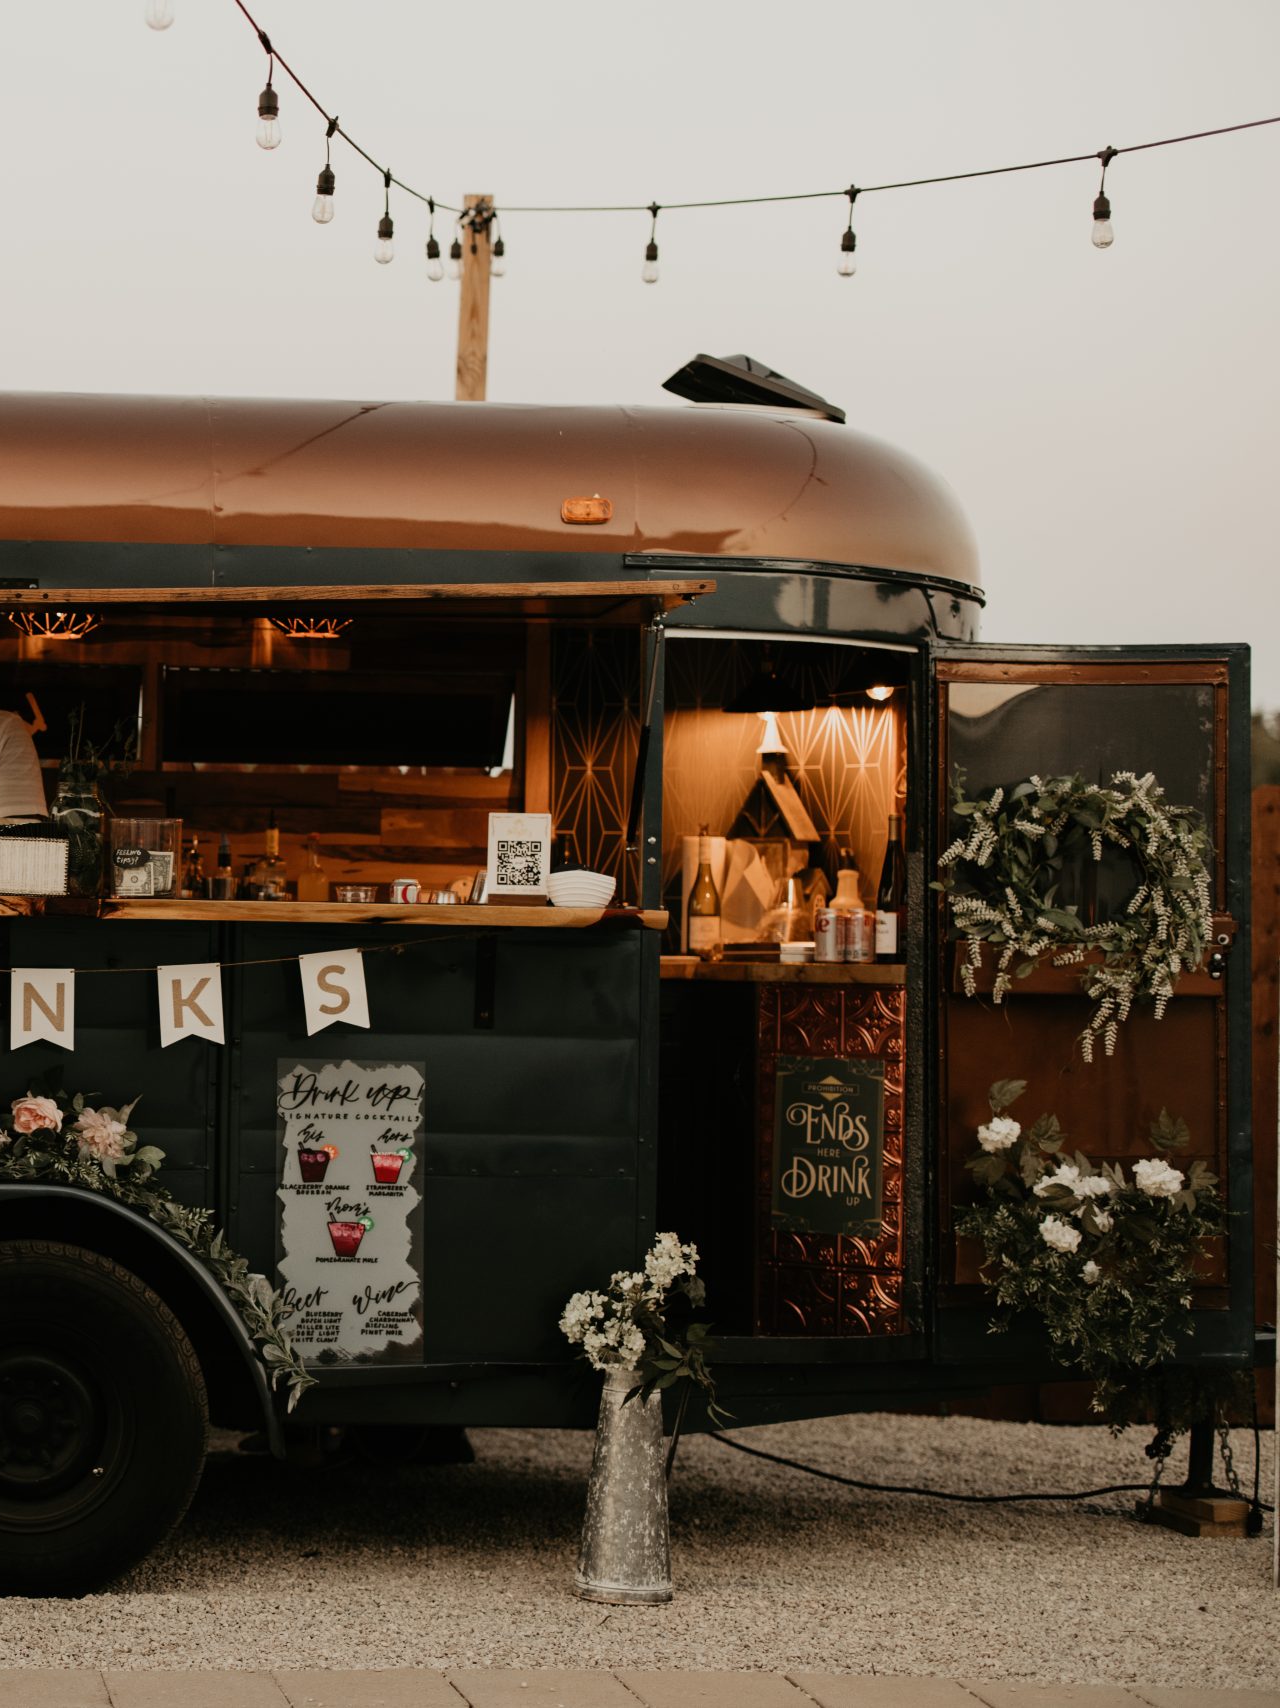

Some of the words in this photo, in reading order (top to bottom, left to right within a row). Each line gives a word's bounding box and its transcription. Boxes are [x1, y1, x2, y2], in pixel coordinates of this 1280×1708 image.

[278, 1073, 359, 1111] Drink
[366, 1082, 425, 1112] up!
[807, 1084, 854, 1093] PROHIBITION
[280, 1112, 349, 1120] SIGNATURE
[355, 1113, 420, 1122] COCKTAILS
[786, 1102, 869, 1151] ENDS
[297, 1123, 325, 1143] his
[377, 1127, 412, 1144] hers
[817, 1149, 840, 1158] HERE
[781, 1155, 872, 1200] DRINK
[846, 1197, 860, 1207] UP
[282, 1286, 329, 1320] Beer
[352, 1281, 421, 1315] Wine
